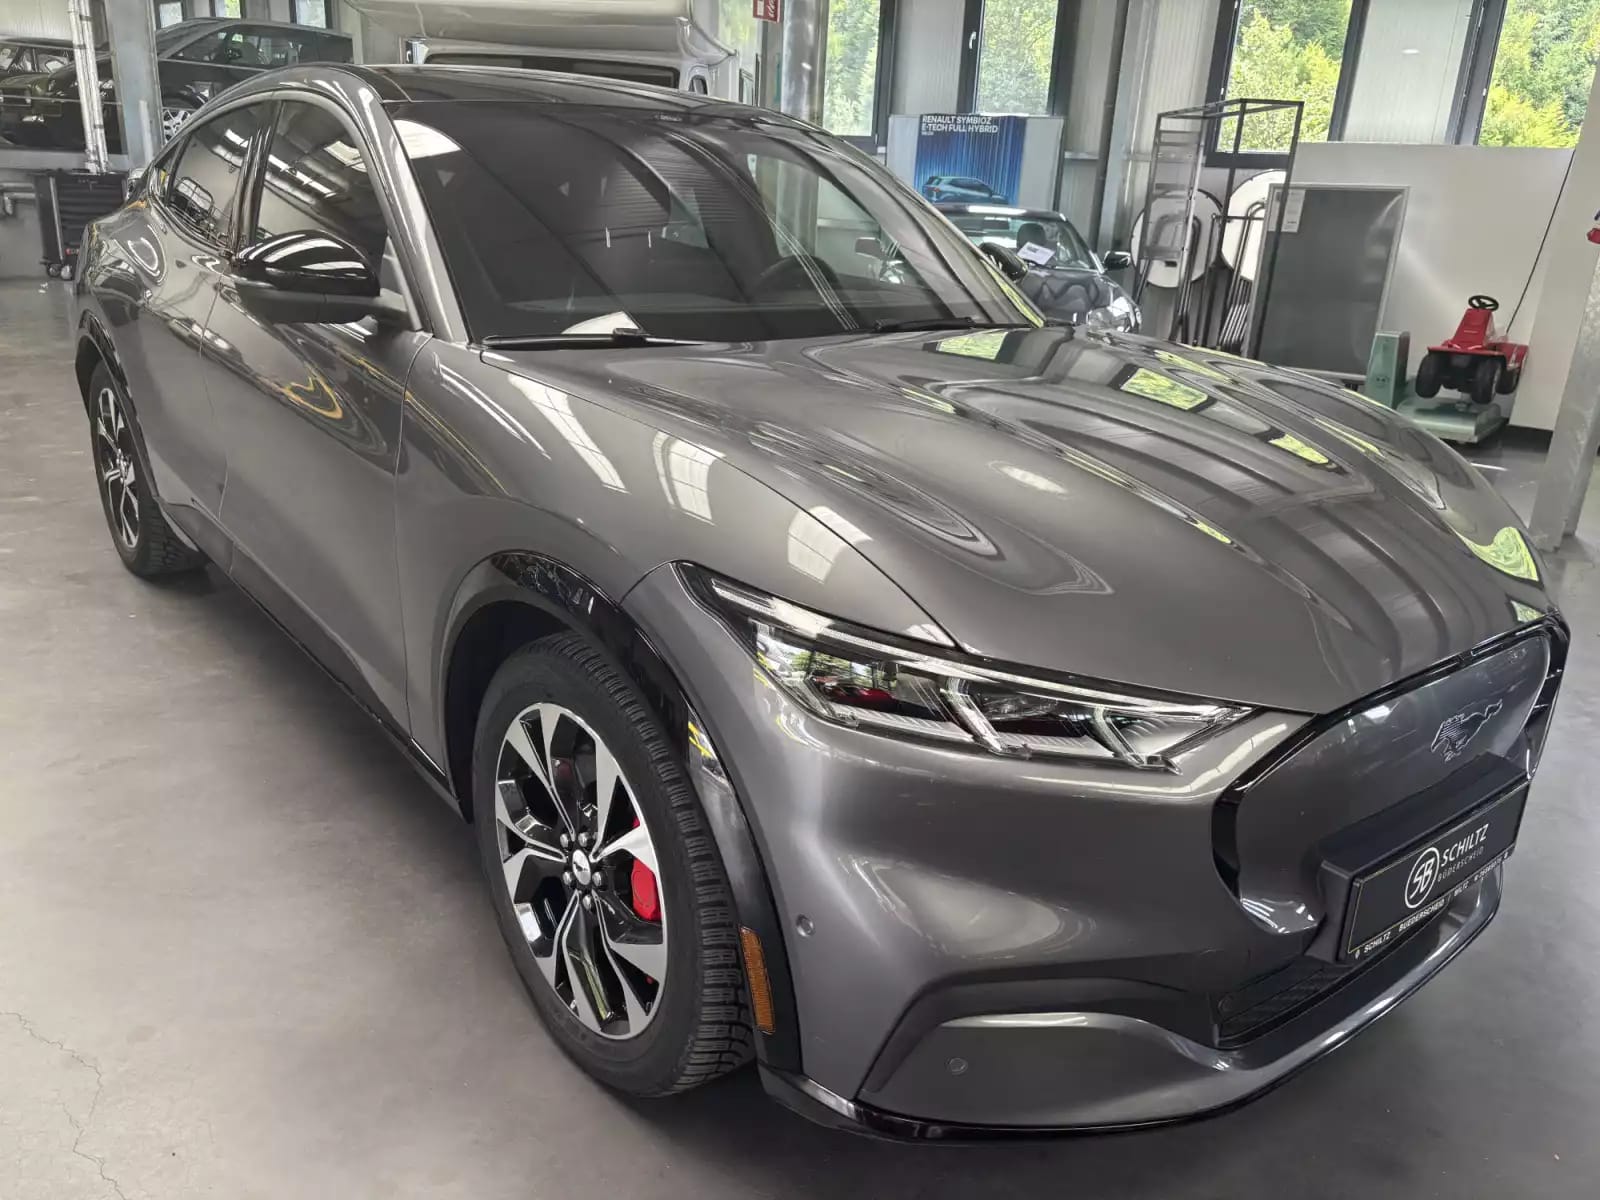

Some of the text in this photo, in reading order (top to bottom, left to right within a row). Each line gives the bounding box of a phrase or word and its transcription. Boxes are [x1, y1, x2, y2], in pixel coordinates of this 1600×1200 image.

[922, 115, 993, 125] RENAULT SYMBIOZ
[948, 124, 967, 132] FULL
[968, 124, 999, 133] HYBRID
[1441, 823, 1489, 868] SCHILTZ
[1364, 931, 1391, 953] SCHILTZ
